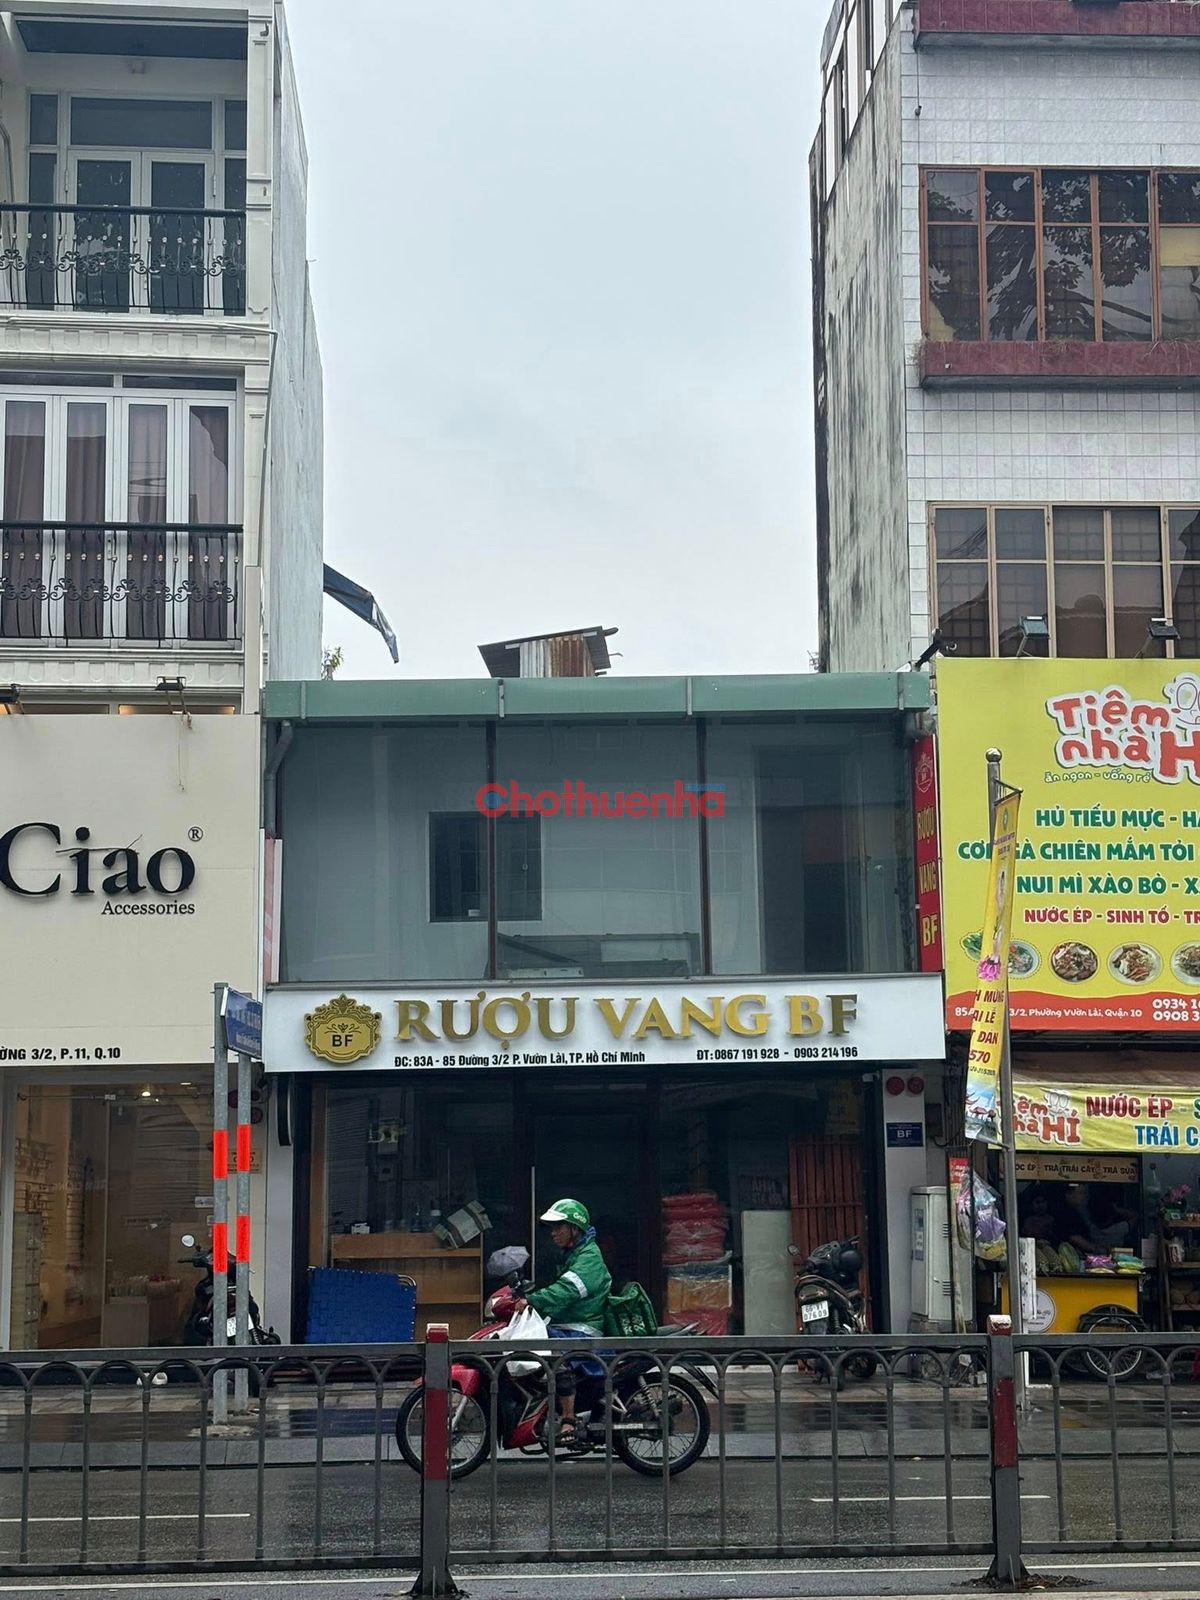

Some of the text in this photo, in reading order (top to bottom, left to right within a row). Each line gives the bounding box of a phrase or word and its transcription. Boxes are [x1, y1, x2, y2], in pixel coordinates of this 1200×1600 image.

[1061, 725, 1151, 762] nhà
[1062, 771, 1093, 783] ngon
[1035, 805, 1065, 828] HỦ
[1070, 803, 1116, 828] TIẾU
[1121, 808, 1165, 832] MỰC
[1182, 811, 1200, 828] H
[958, 840, 993, 860] CƠ
[1040, 840, 1103, 861] CHIÊN
[1107, 836, 1155, 861] MẮM
[1160, 840, 1194, 861] TỎI
[0, 821, 196, 896] Ciao
[919, 860, 938, 895] VANG
[1016, 876, 1054, 894] NUI
[1059, 873, 1083, 894] MÌ
[1088, 873, 1133, 895] XÀO
[1138, 873, 1167, 895] BÒ
[100, 899, 196, 916] Accessories
[1024, 906, 1069, 924] NƯỚC
[1073, 905, 1092, 924] ÉP
[1107, 909, 1145, 924] SINH
[1149, 906, 1170, 924] TỐ
[921, 914, 939, 948] BF
[1029, 1007, 1062, 1018] Phường
[1063, 1007, 1087, 1017] Vườn
[1130, 1008, 1143, 1018] 10
[1152, 998, 1200, 1010] 0934 1
[393, 990, 859, 1050] RƯỢU VANG BF
[1152, 1010, 1200, 1022] 0908 3
[332, 1034, 354, 1048] BF
[31, 1047, 58, 1061] 3/2,
[94, 1047, 121, 1060] Q.10
[413, 1056, 434, 1067] 83A
[442, 1055, 456, 1067] 85
[458, 1054, 490, 1067] Đường
[491, 1054, 510, 1065] 3/2
[512, 1053, 521, 1065] P.
[522, 1053, 548, 1065] Vườn
[586, 1050, 600, 1064] Hồ
[601, 1050, 618, 1063] Chí
[741, 1049, 758, 1060] 191
[760, 1048, 780, 1059] 928
[793, 1047, 819, 1059] 0903
[821, 1047, 840, 1058] 214
[840, 1046, 859, 1058] 196
[968, 1050, 991, 1064] 570
[1086, 1093, 1141, 1118] NƯỚC
[1147, 1094, 1173, 1119] ÉP
[896, 1129, 912, 1139] BF
[1135, 1121, 1179, 1146] TRÁI
